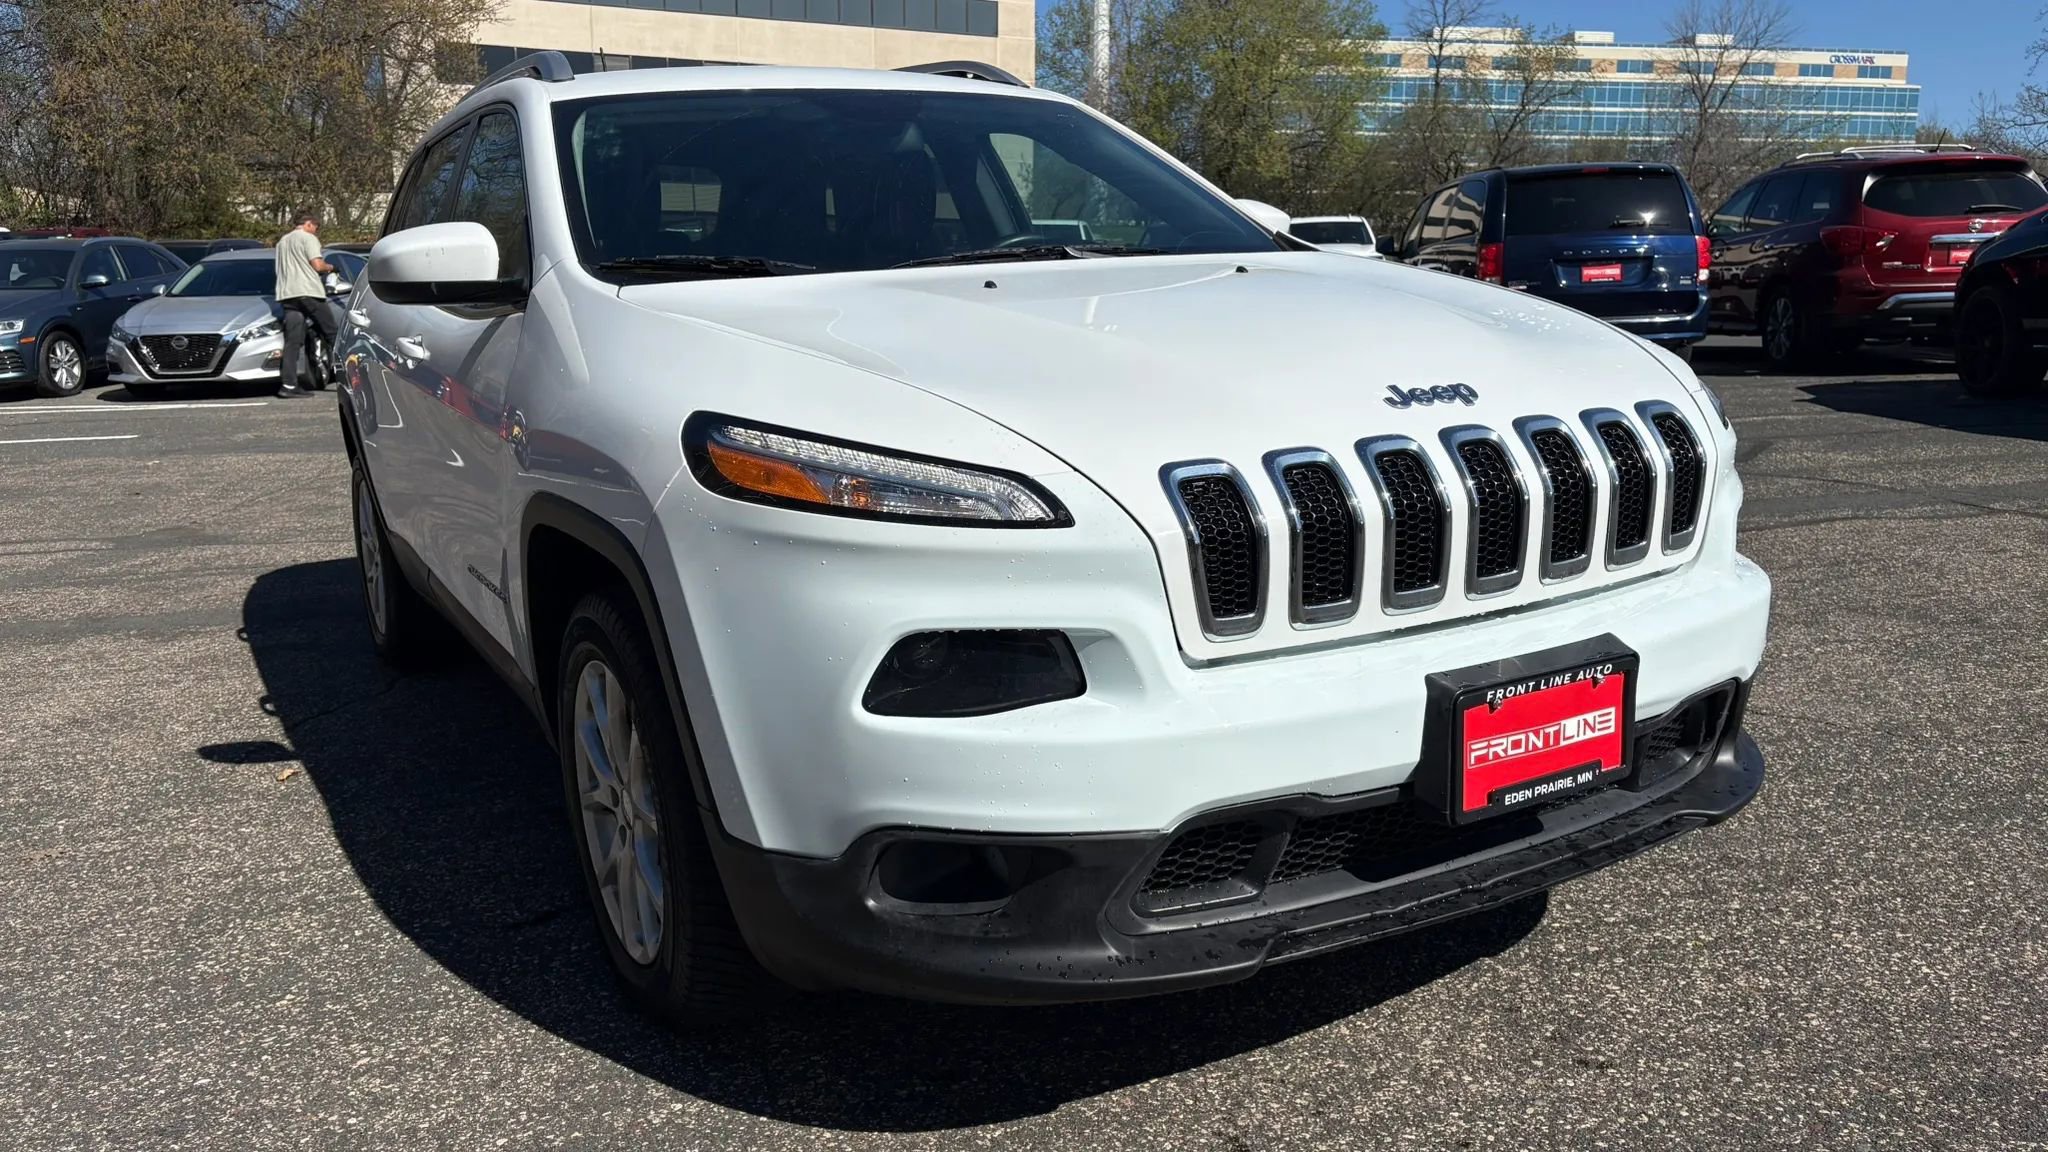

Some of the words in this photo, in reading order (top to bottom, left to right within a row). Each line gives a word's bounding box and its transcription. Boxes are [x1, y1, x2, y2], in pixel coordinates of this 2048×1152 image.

[1382, 382, 1479, 410] Jeep
[1486, 681, 1536, 703] FRONT
[1540, 673, 1572, 690] LINE
[1576, 663, 1613, 681] AUTO
[1504, 788, 1533, 806] EDEN
[1534, 776, 1576, 797] PRAIRIE,
[1577, 771, 1593, 785] MN
